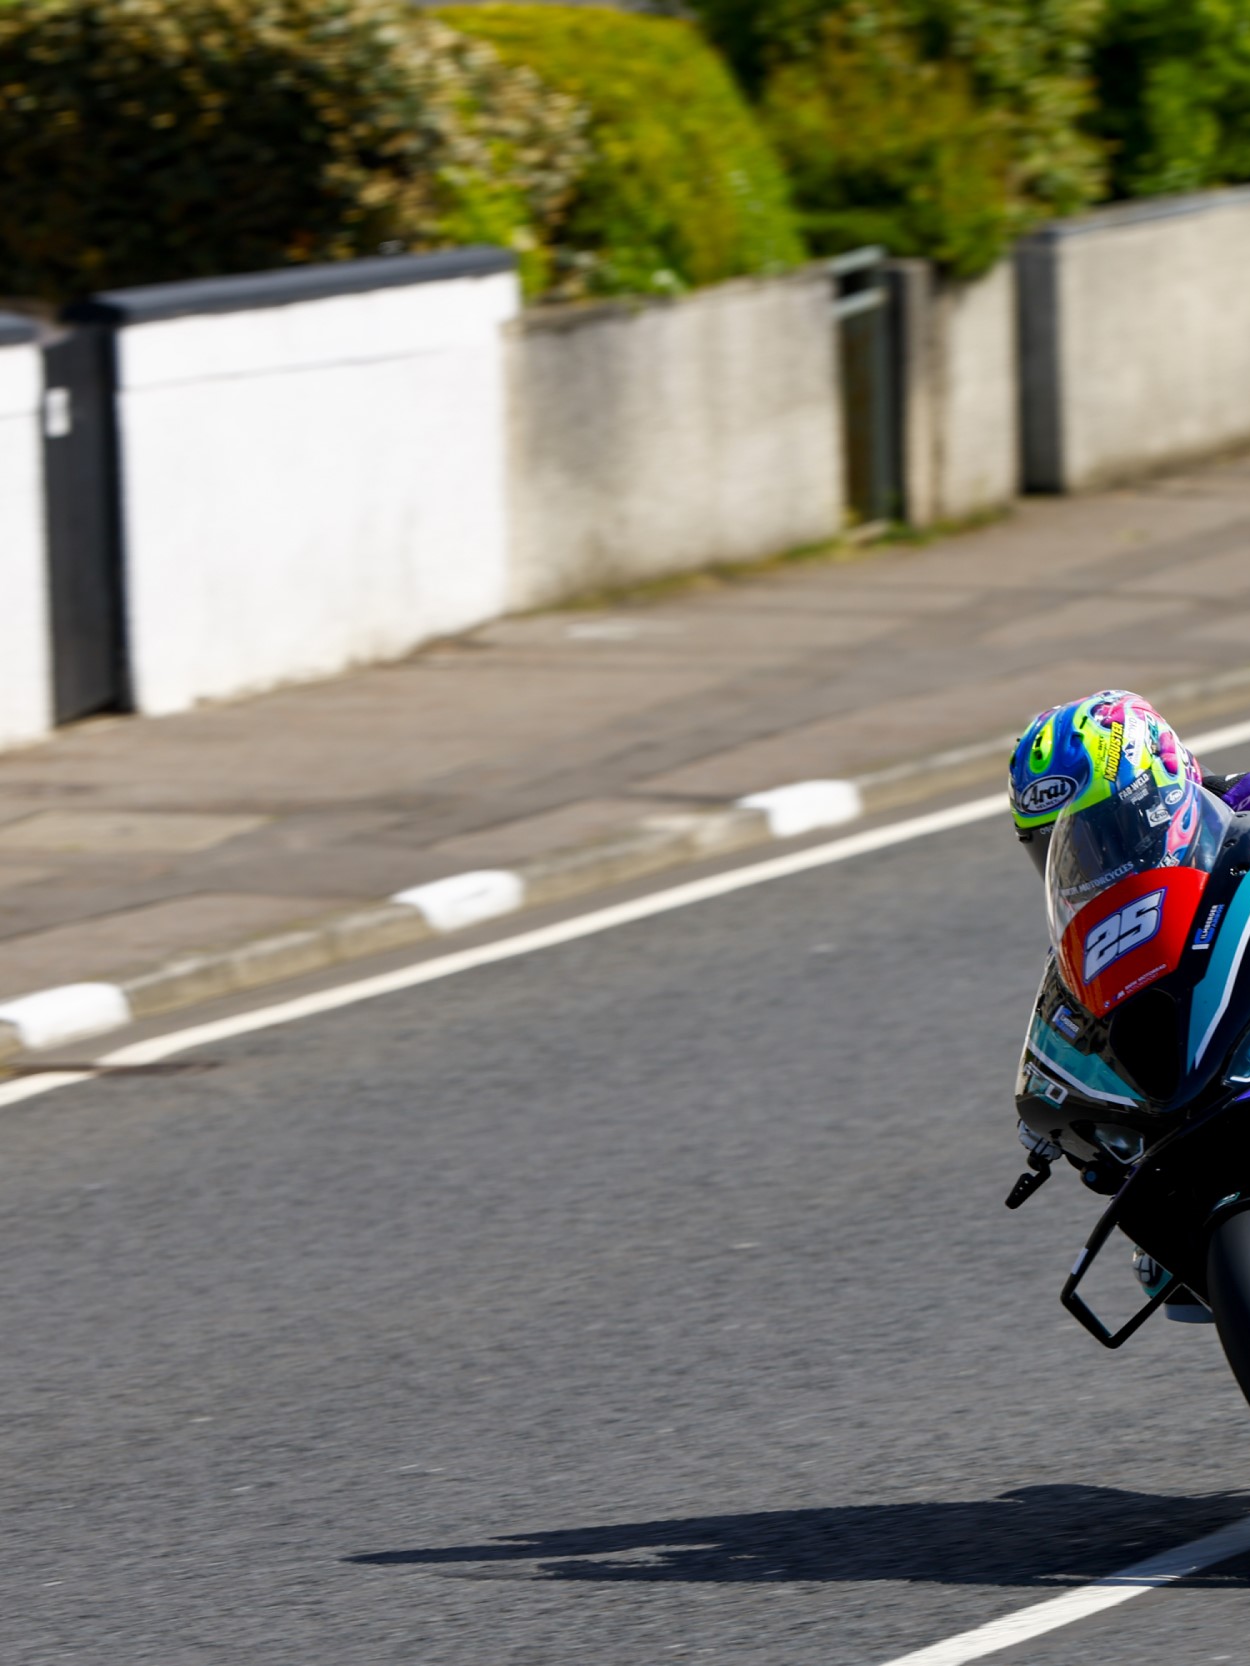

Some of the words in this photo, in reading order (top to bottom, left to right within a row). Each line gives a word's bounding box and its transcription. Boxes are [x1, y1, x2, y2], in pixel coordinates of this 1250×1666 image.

[1103, 721, 1124, 782] MUDBUSTER
[1023, 778, 1069, 811] Arai
[1078, 861, 1134, 893] MOTORCYCLES
[1084, 888, 1167, 984] 25
